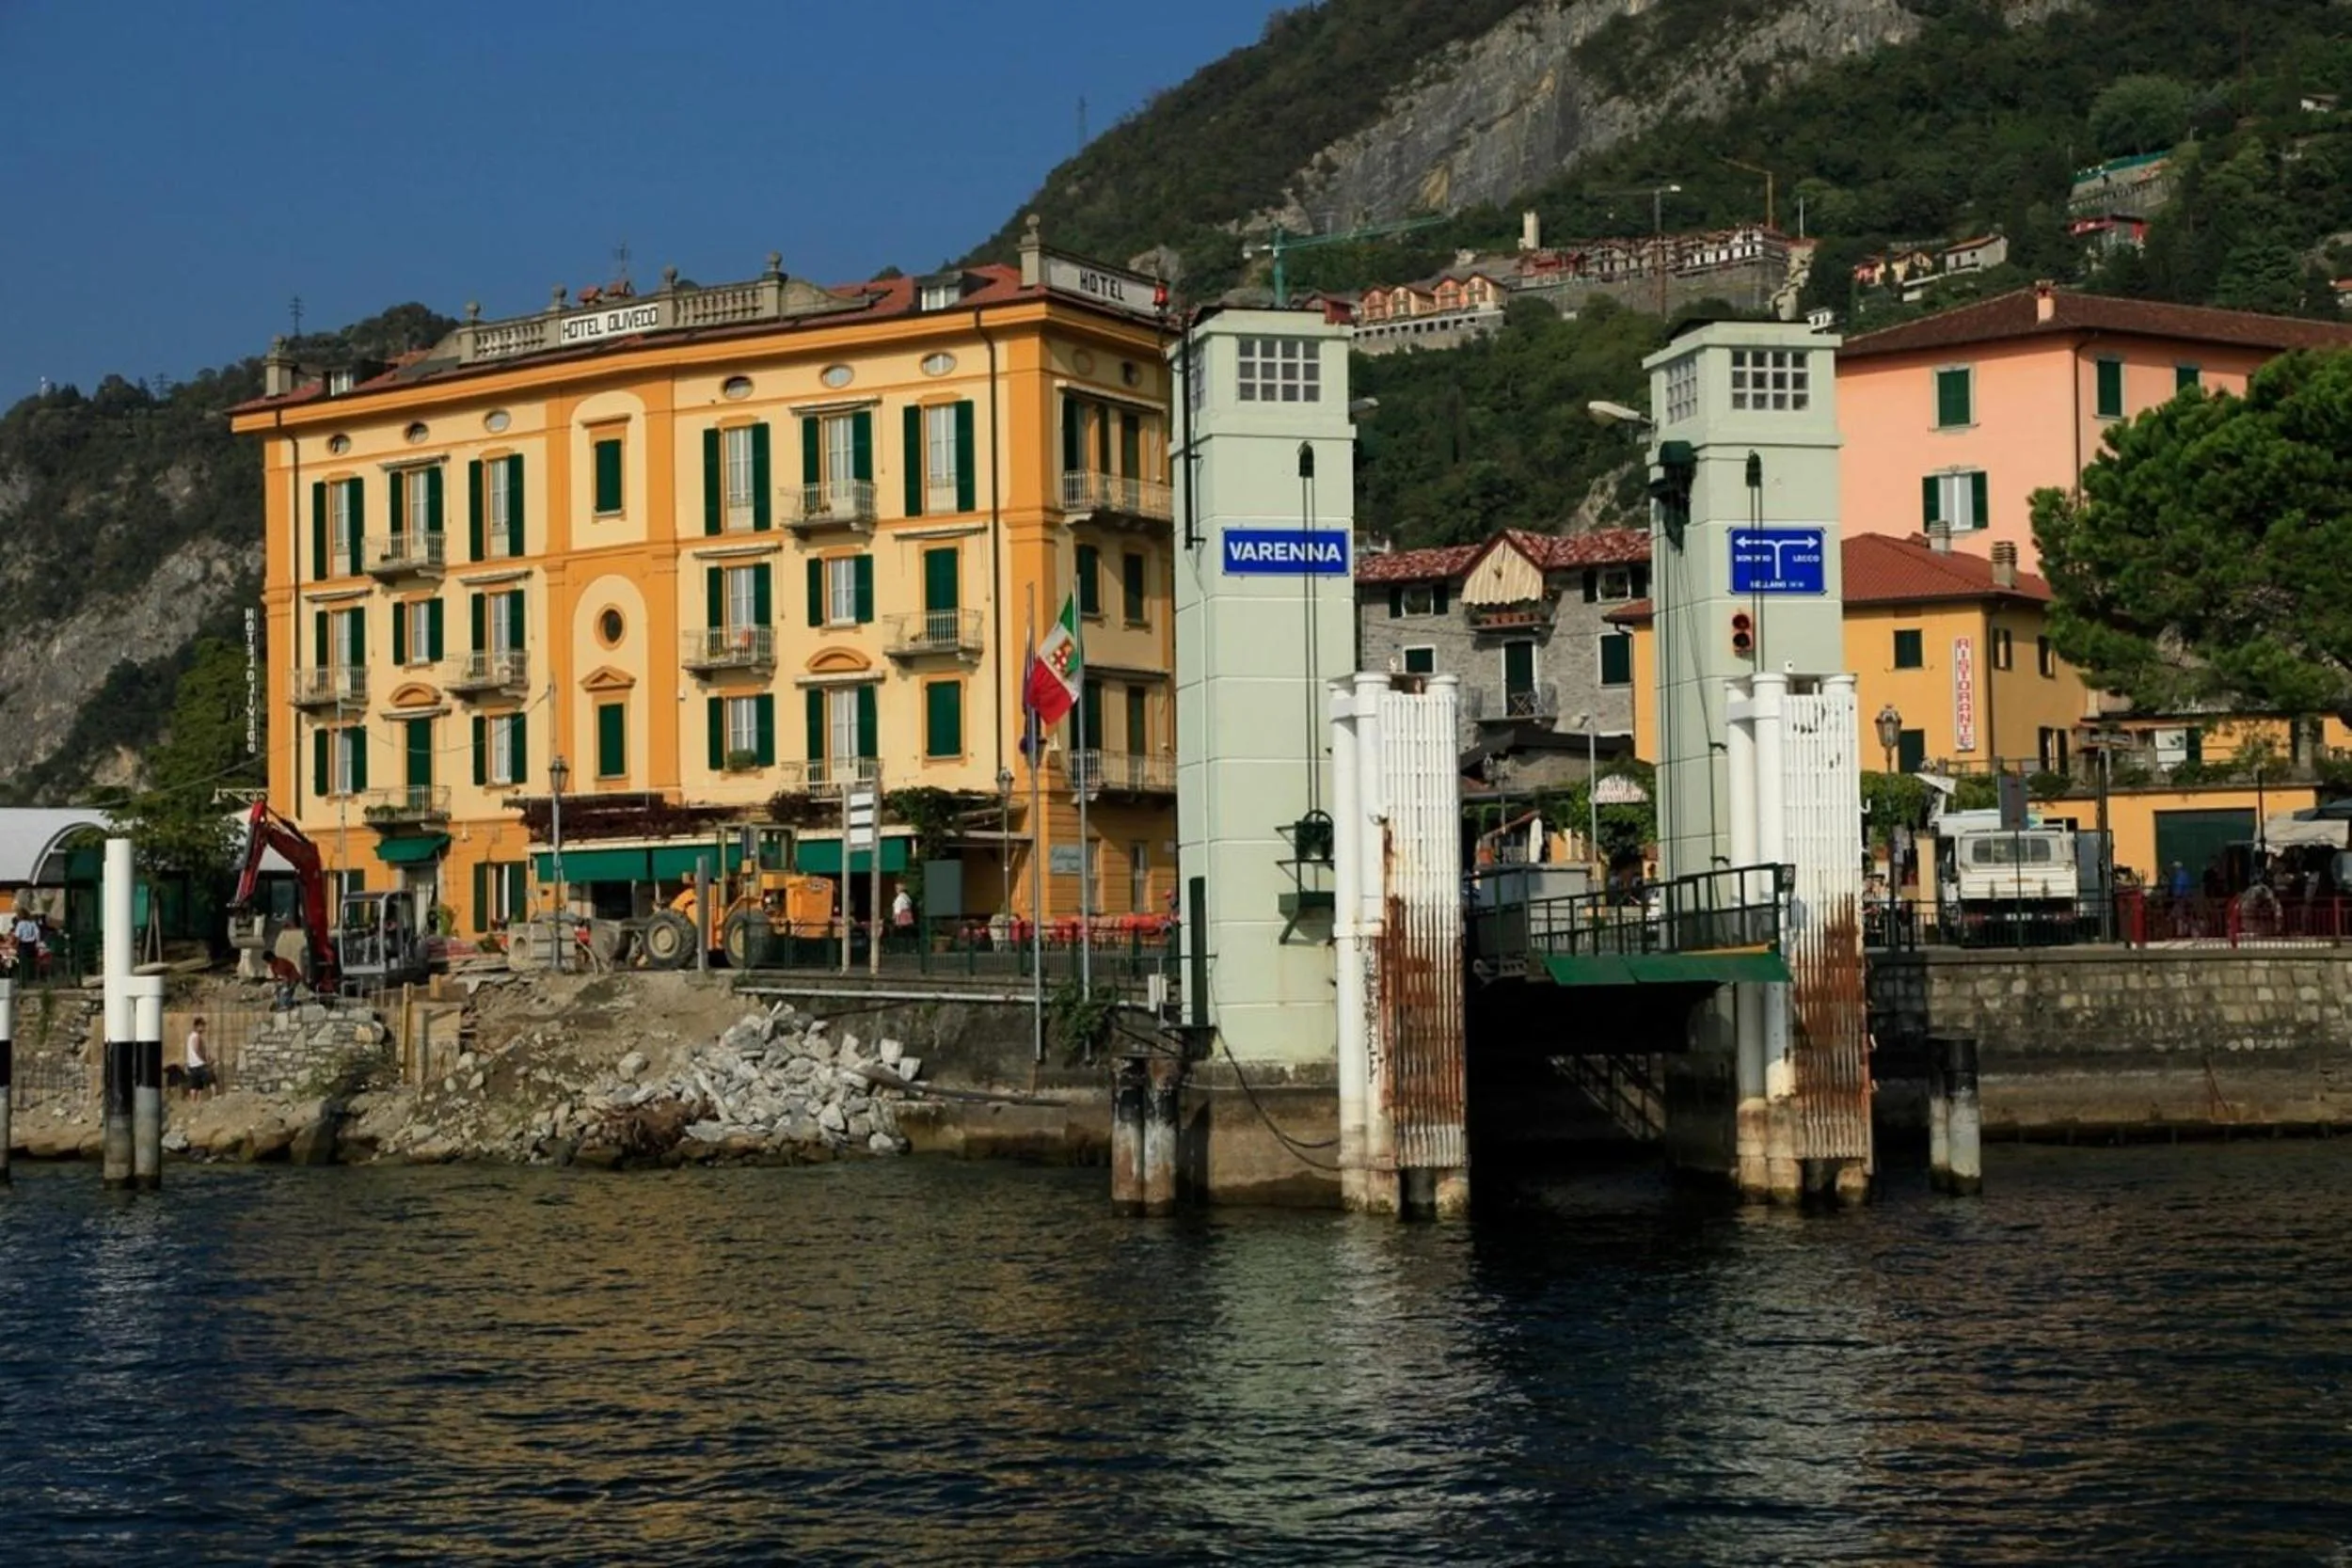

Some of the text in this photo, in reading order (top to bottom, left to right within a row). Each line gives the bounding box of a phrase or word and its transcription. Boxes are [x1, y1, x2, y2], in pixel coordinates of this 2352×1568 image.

[1079, 269, 1125, 301] HOTEL
[563, 307, 659, 340] HOTEL OLIVEDO
[1229, 541, 1343, 562] VARENNA
[1957, 638, 1972, 747] RISTORANTE
